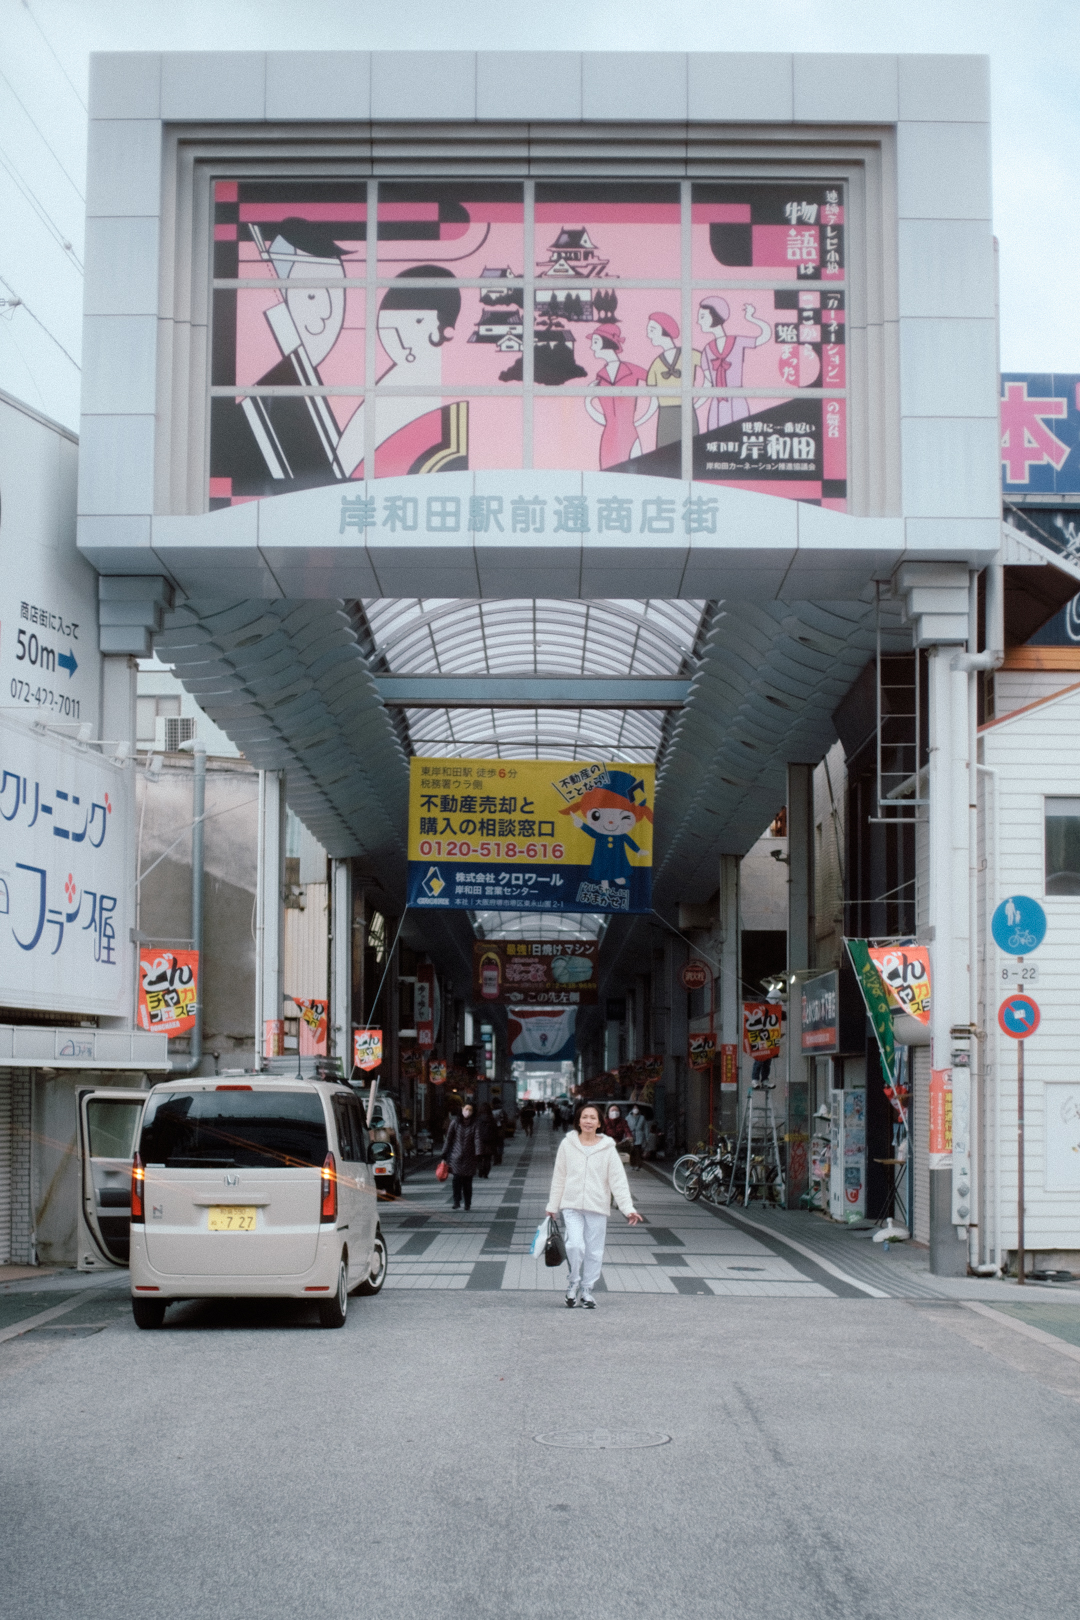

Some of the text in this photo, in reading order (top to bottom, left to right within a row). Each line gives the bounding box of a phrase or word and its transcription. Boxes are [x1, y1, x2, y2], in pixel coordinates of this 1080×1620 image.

[785, 201, 819, 275] 物語は
[825, 190, 839, 274] 連続テレビ小説
[776, 325, 798, 381] 始まった
[742, 421, 816, 434] 世界に一番近い
[740, 434, 816, 460] 岸和田
[338, 495, 720, 534] 岸和田駅前通商店街
[16, 628, 56, 673] 50m
[421, 766, 518, 779] 東岸和田駅 徒歩6分
[559, 764, 601, 788] 不動産の
[421, 779, 483, 790] 税務署ウラ側
[419, 794, 535, 815] 不動産売却と
[419, 817, 555, 838] 購入の相談窓口
[419, 840, 564, 860] 0120-518-616
[455, 871, 564, 887] 株式会社 クロワール
[455, 885, 539, 896] 岸和田 営業センター
[1001, 968, 1036, 980] 8-22
